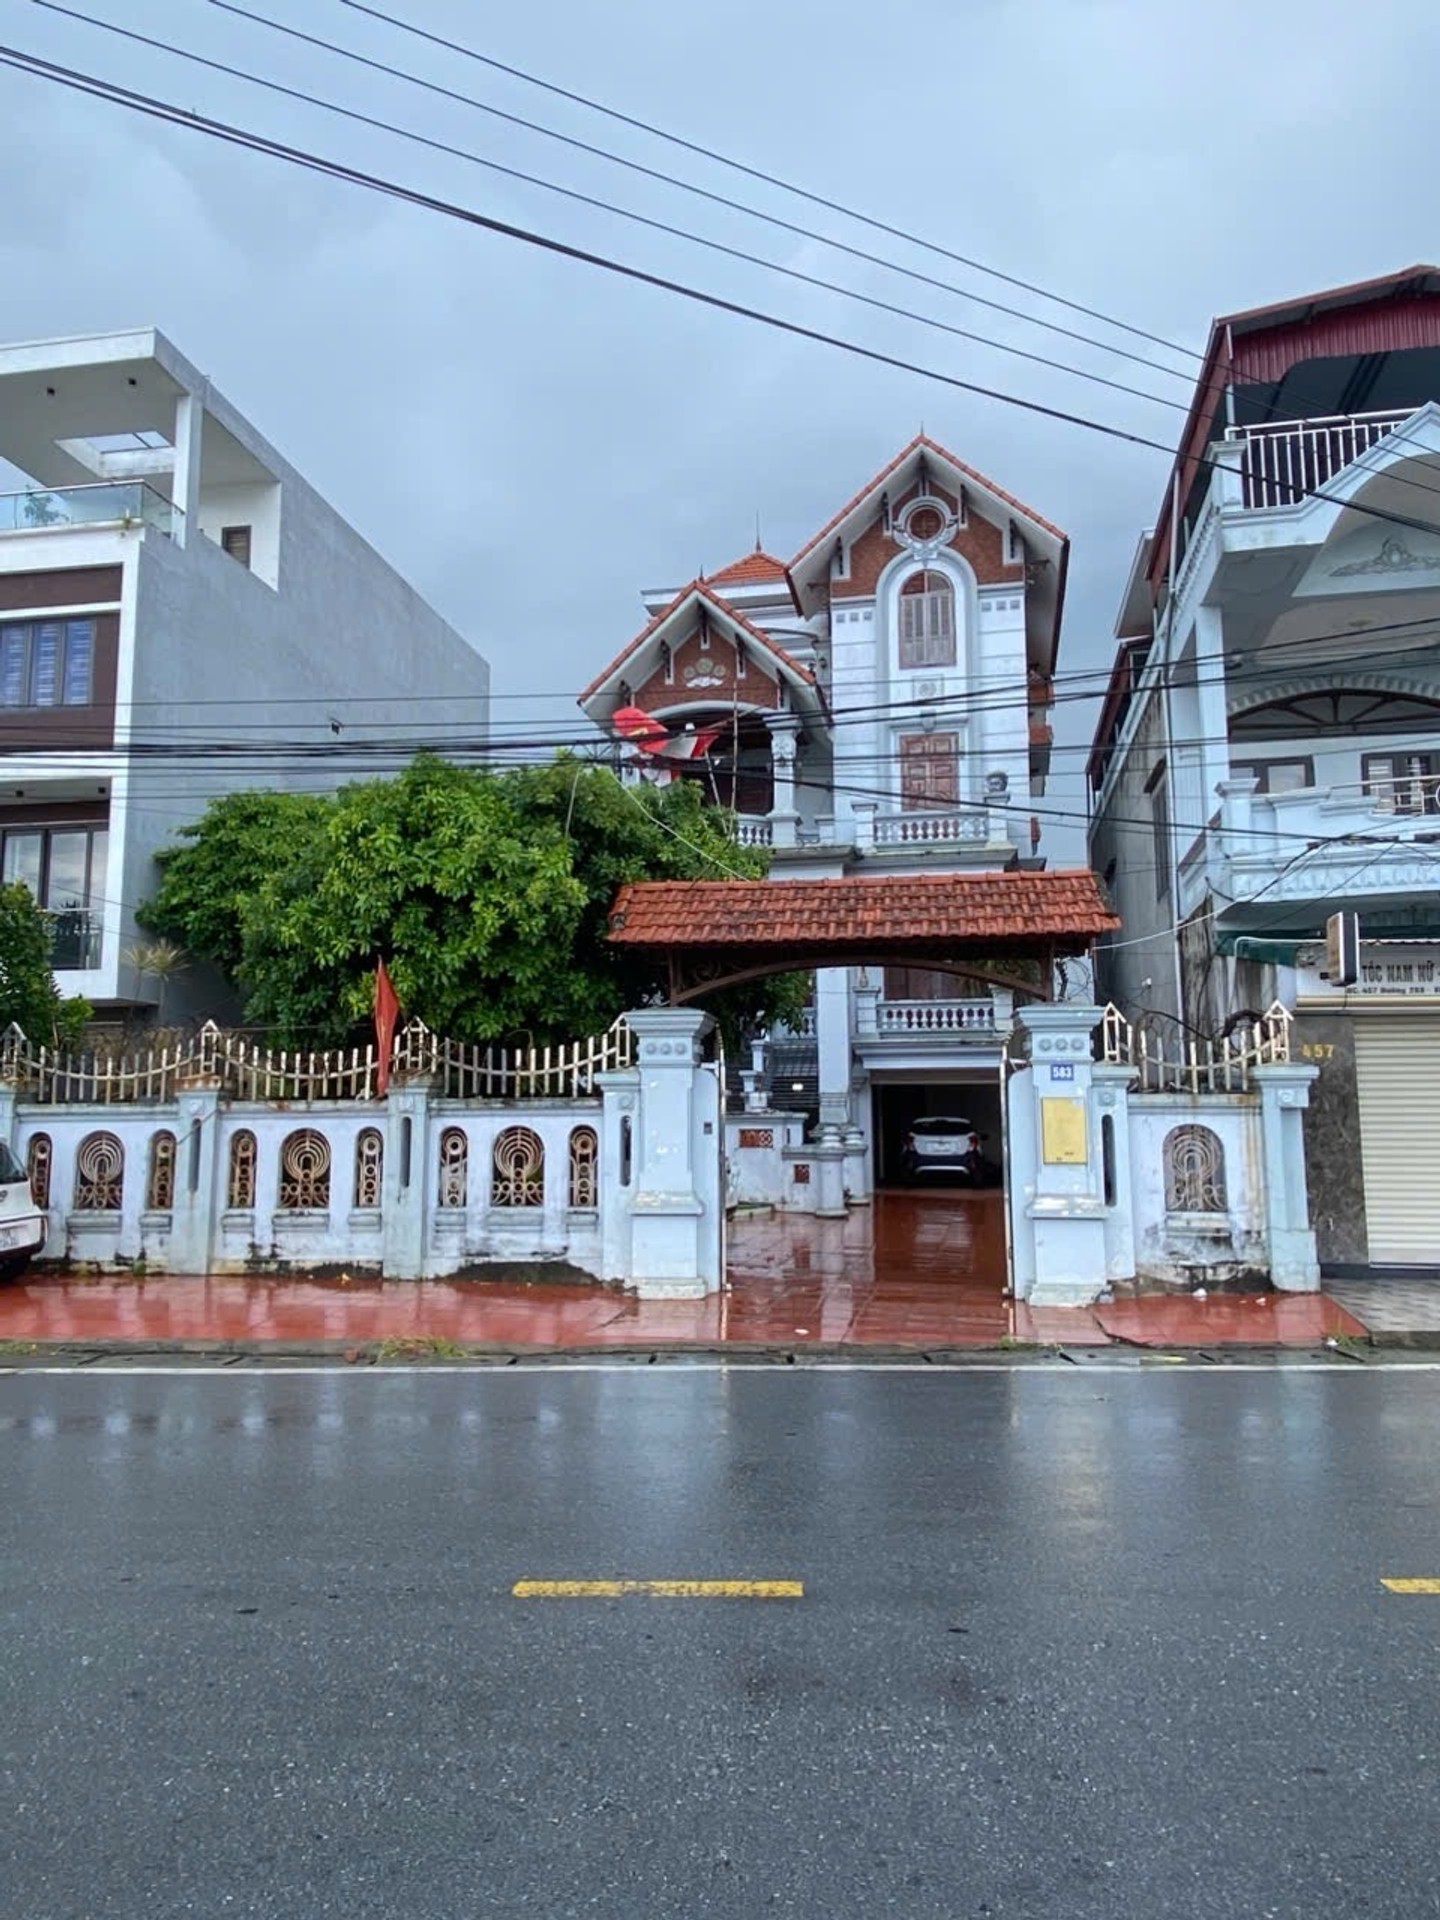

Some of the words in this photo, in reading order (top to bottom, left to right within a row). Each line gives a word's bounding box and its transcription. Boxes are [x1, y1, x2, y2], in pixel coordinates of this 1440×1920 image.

[1387, 964, 1413, 982] NAM
[1302, 1044, 1334, 1058] 457
[1053, 1066, 1071, 1078] 583
